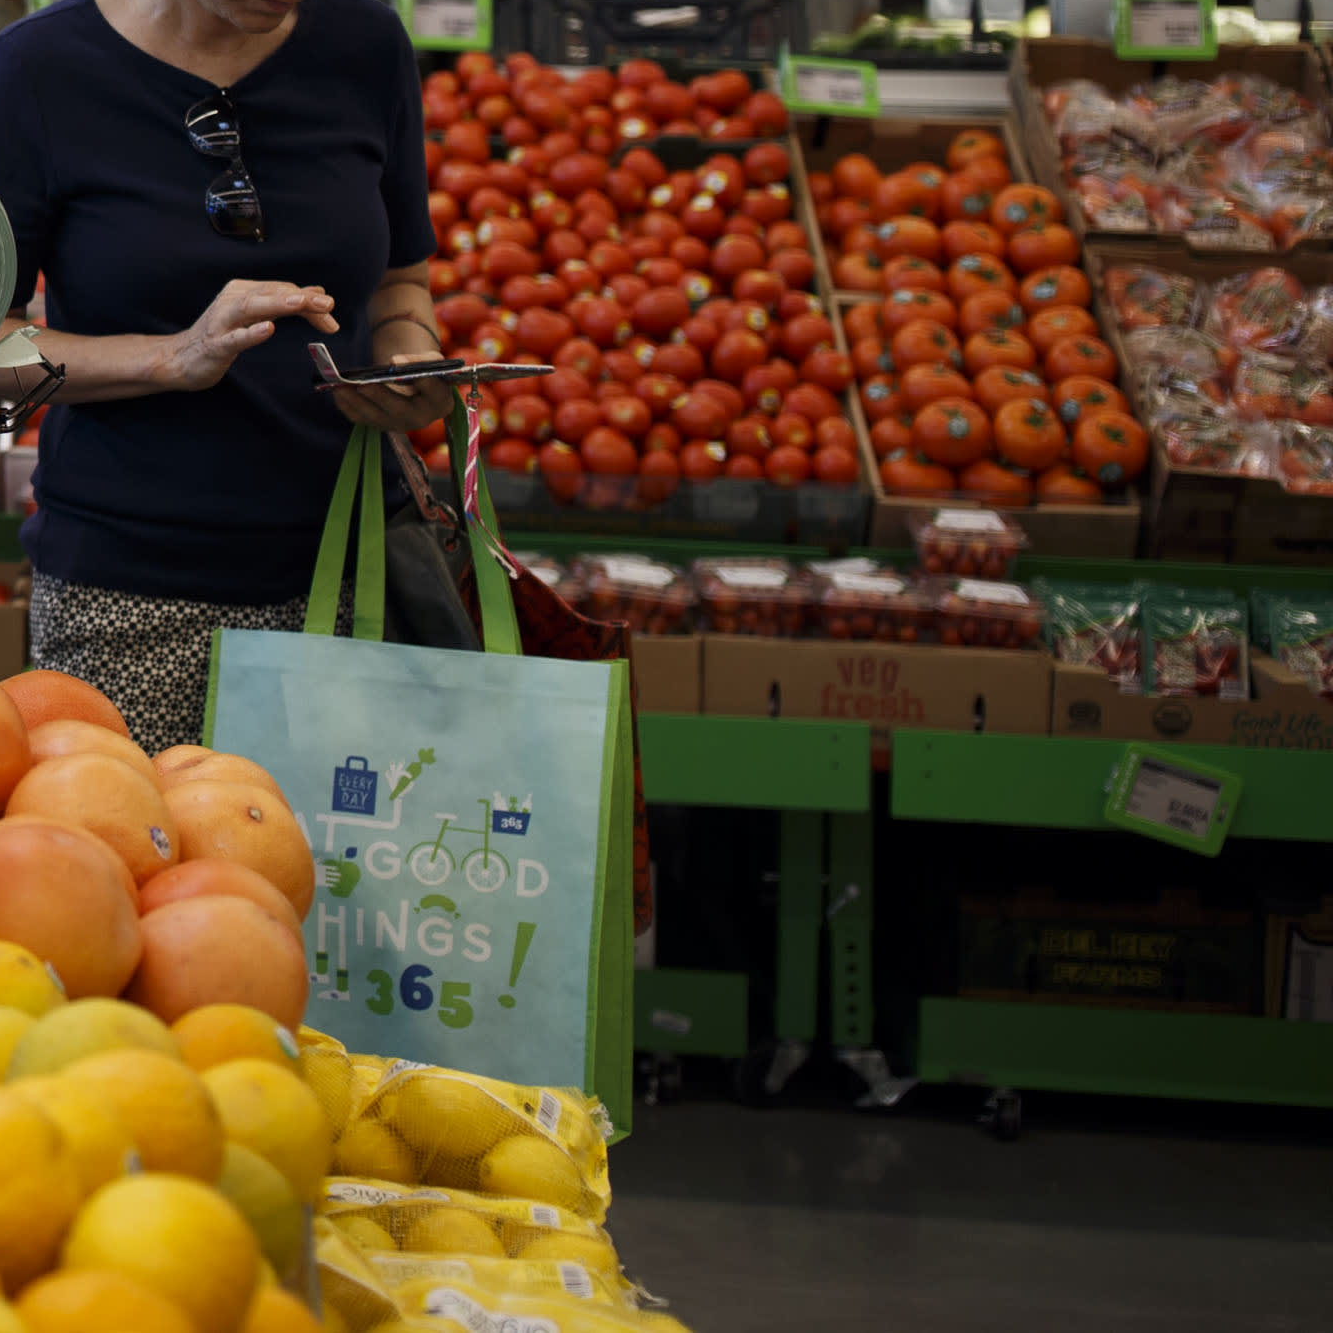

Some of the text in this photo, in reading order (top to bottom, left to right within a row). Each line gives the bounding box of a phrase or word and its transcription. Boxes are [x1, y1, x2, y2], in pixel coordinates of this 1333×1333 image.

[836, 656, 902, 694] veg
[820, 682, 926, 723] fresh
[338, 773, 374, 792] EVERY
[341, 790, 369, 807] DAY
[500, 817, 523, 831] 365
[365, 841, 550, 898] GOOD
[365, 964, 474, 1029] 365
